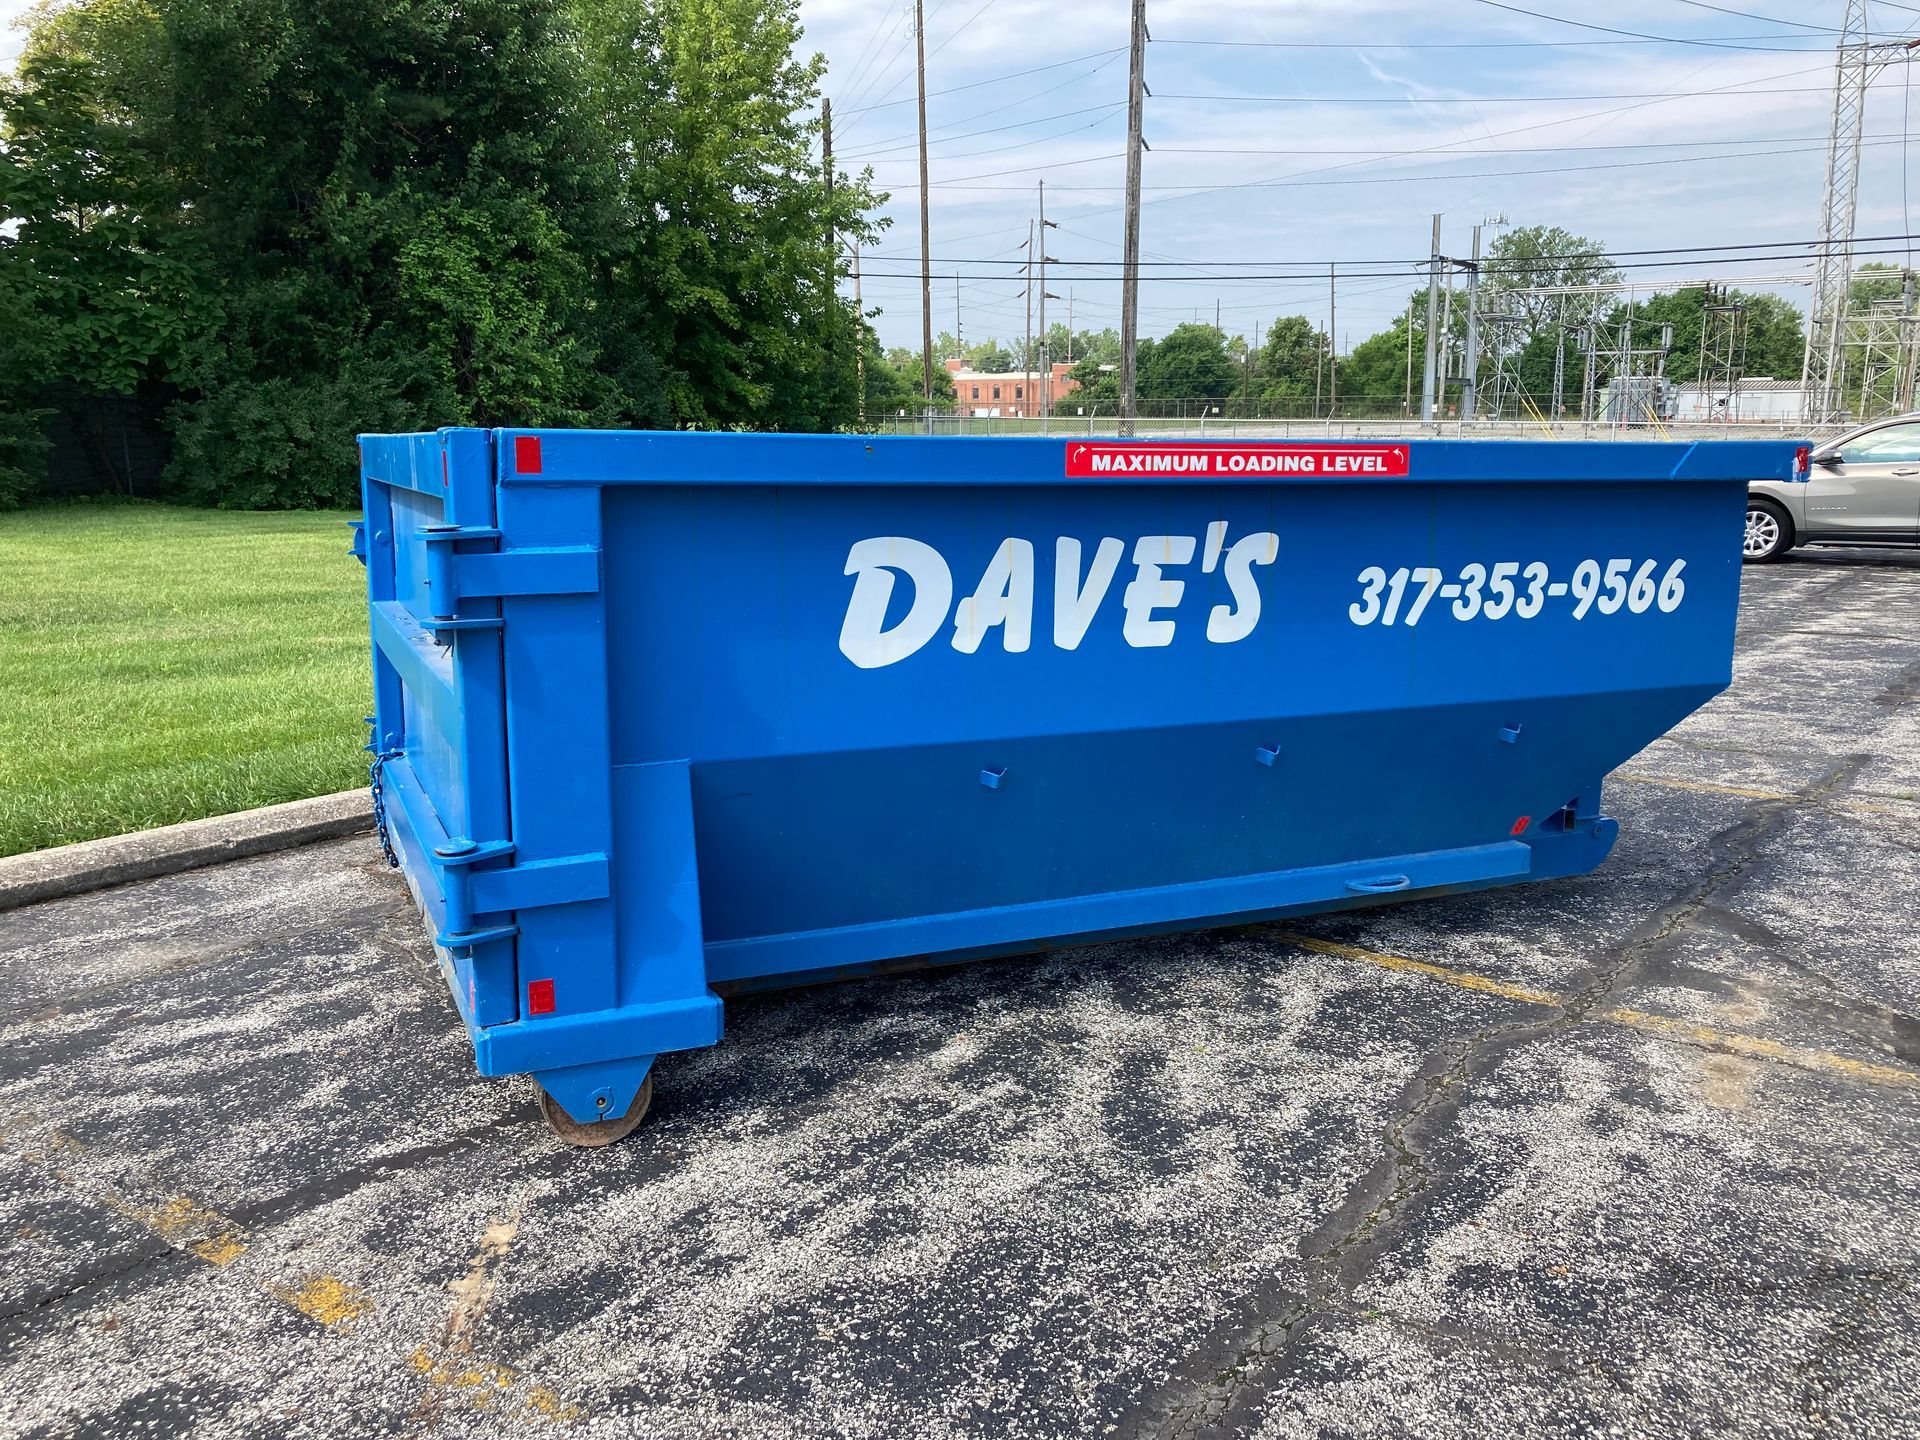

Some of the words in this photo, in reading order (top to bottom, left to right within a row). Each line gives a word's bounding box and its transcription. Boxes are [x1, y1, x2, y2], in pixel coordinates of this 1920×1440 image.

[1091, 455, 1208, 472] MAXIMUM
[1216, 455, 1315, 472] LOADING
[1322, 456, 1388, 472] LEVEL
[839, 521, 1280, 669] DAVE'S
[1349, 559, 1687, 627] 317-353-9566
